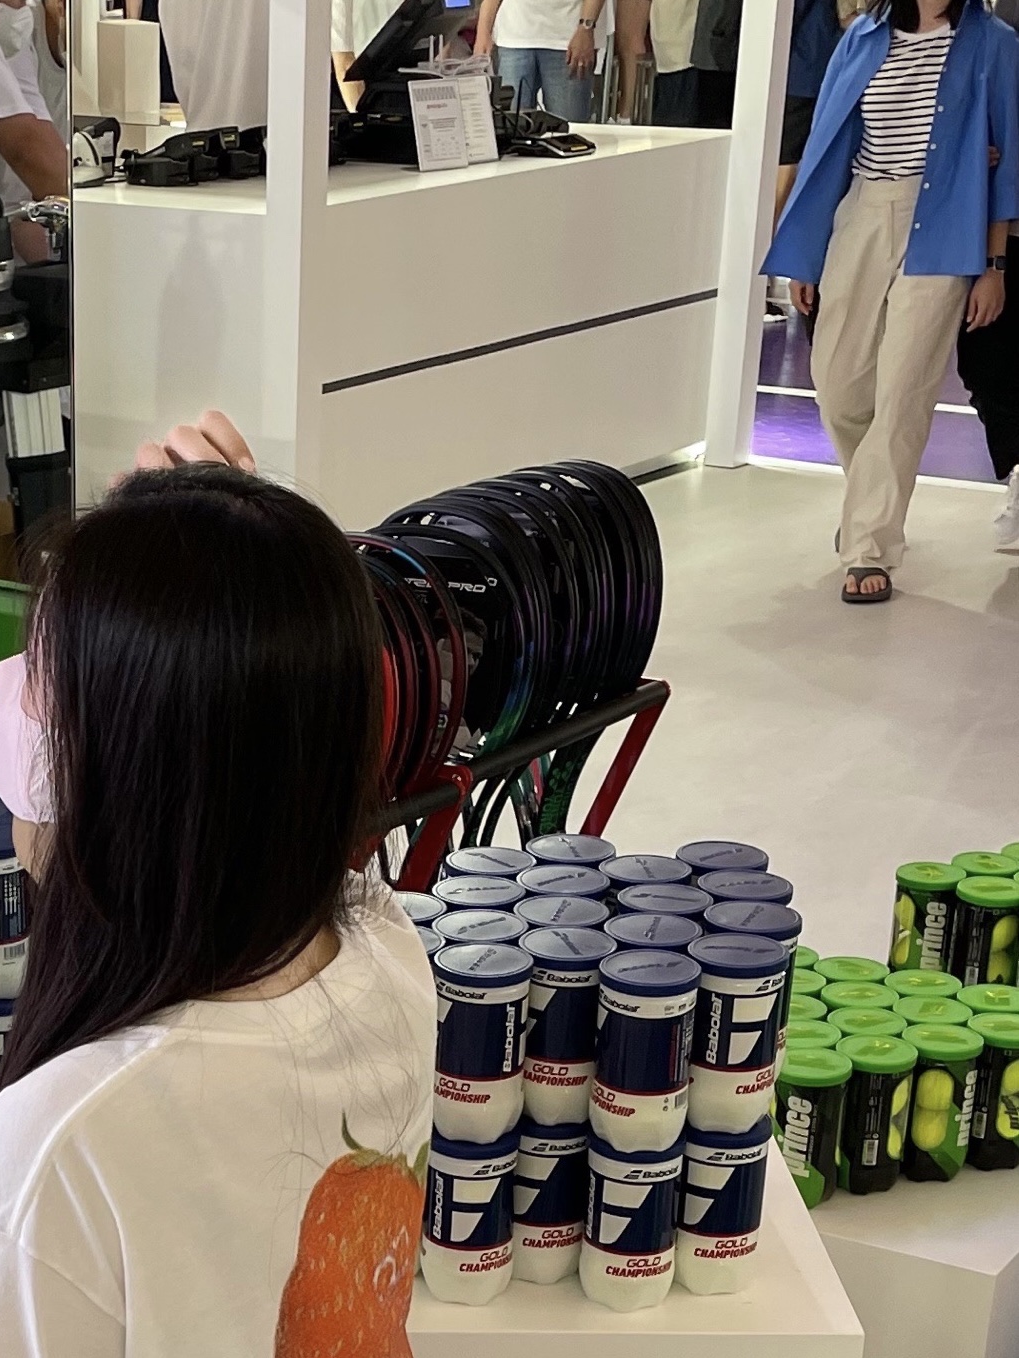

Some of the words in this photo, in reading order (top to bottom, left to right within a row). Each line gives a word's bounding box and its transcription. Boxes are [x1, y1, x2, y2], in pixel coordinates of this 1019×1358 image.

[548, 973, 593, 983] Babolat
[445, 985, 487, 1000] Babolat
[706, 993, 723, 1065] Babolat
[503, 1003, 516, 1073] Babolat
[533, 1063, 569, 1077] GOLD
[755, 1069, 775, 1083] GOL
[439, 1077, 471, 1092] GOLD
[523, 1069, 588, 1087] AMPIONSHIP
[434, 1084, 491, 1104] AMPIONSHIP
[955, 1069, 978, 1147] prince
[777, 1095, 813, 1178] prince
[549, 1138, 587, 1151] Babolat
[725, 1149, 763, 1162] Babolat
[642, 1165, 680, 1179] Babolat
[433, 1171, 444, 1240] Babolat
[542, 1227, 575, 1240] GOLD
[715, 1237, 749, 1249] GOLD
[480, 1246, 509, 1262] GOLD
[626, 1256, 662, 1268] GOLD
